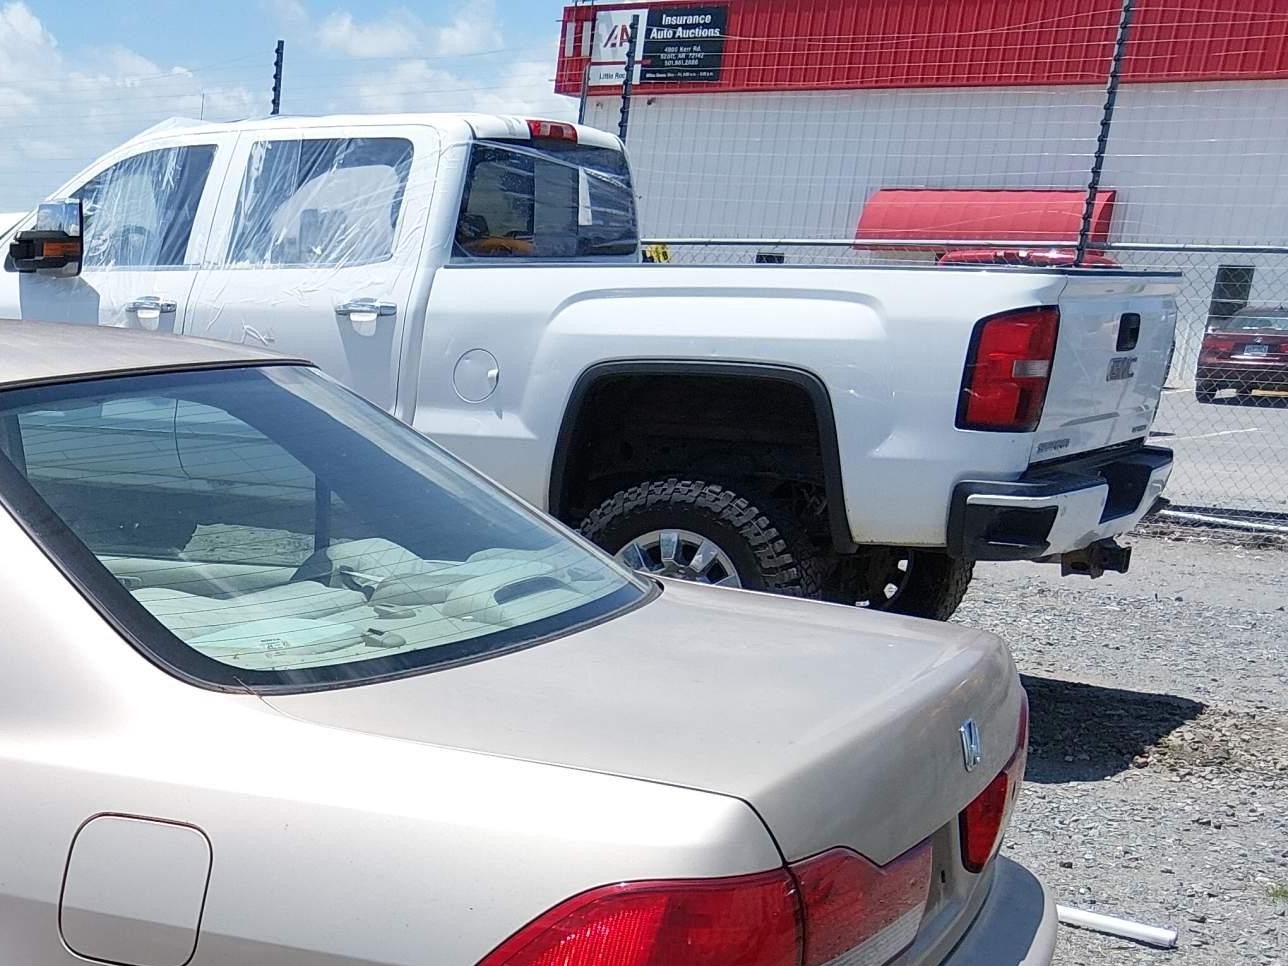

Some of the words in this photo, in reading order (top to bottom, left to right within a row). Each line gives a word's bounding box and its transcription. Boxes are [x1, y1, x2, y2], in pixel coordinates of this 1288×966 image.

[662, 14, 711, 25] Insurance
[650, 28, 673, 39] Auto
[675, 26, 720, 38] Auctions
[599, 72, 614, 80] Little
